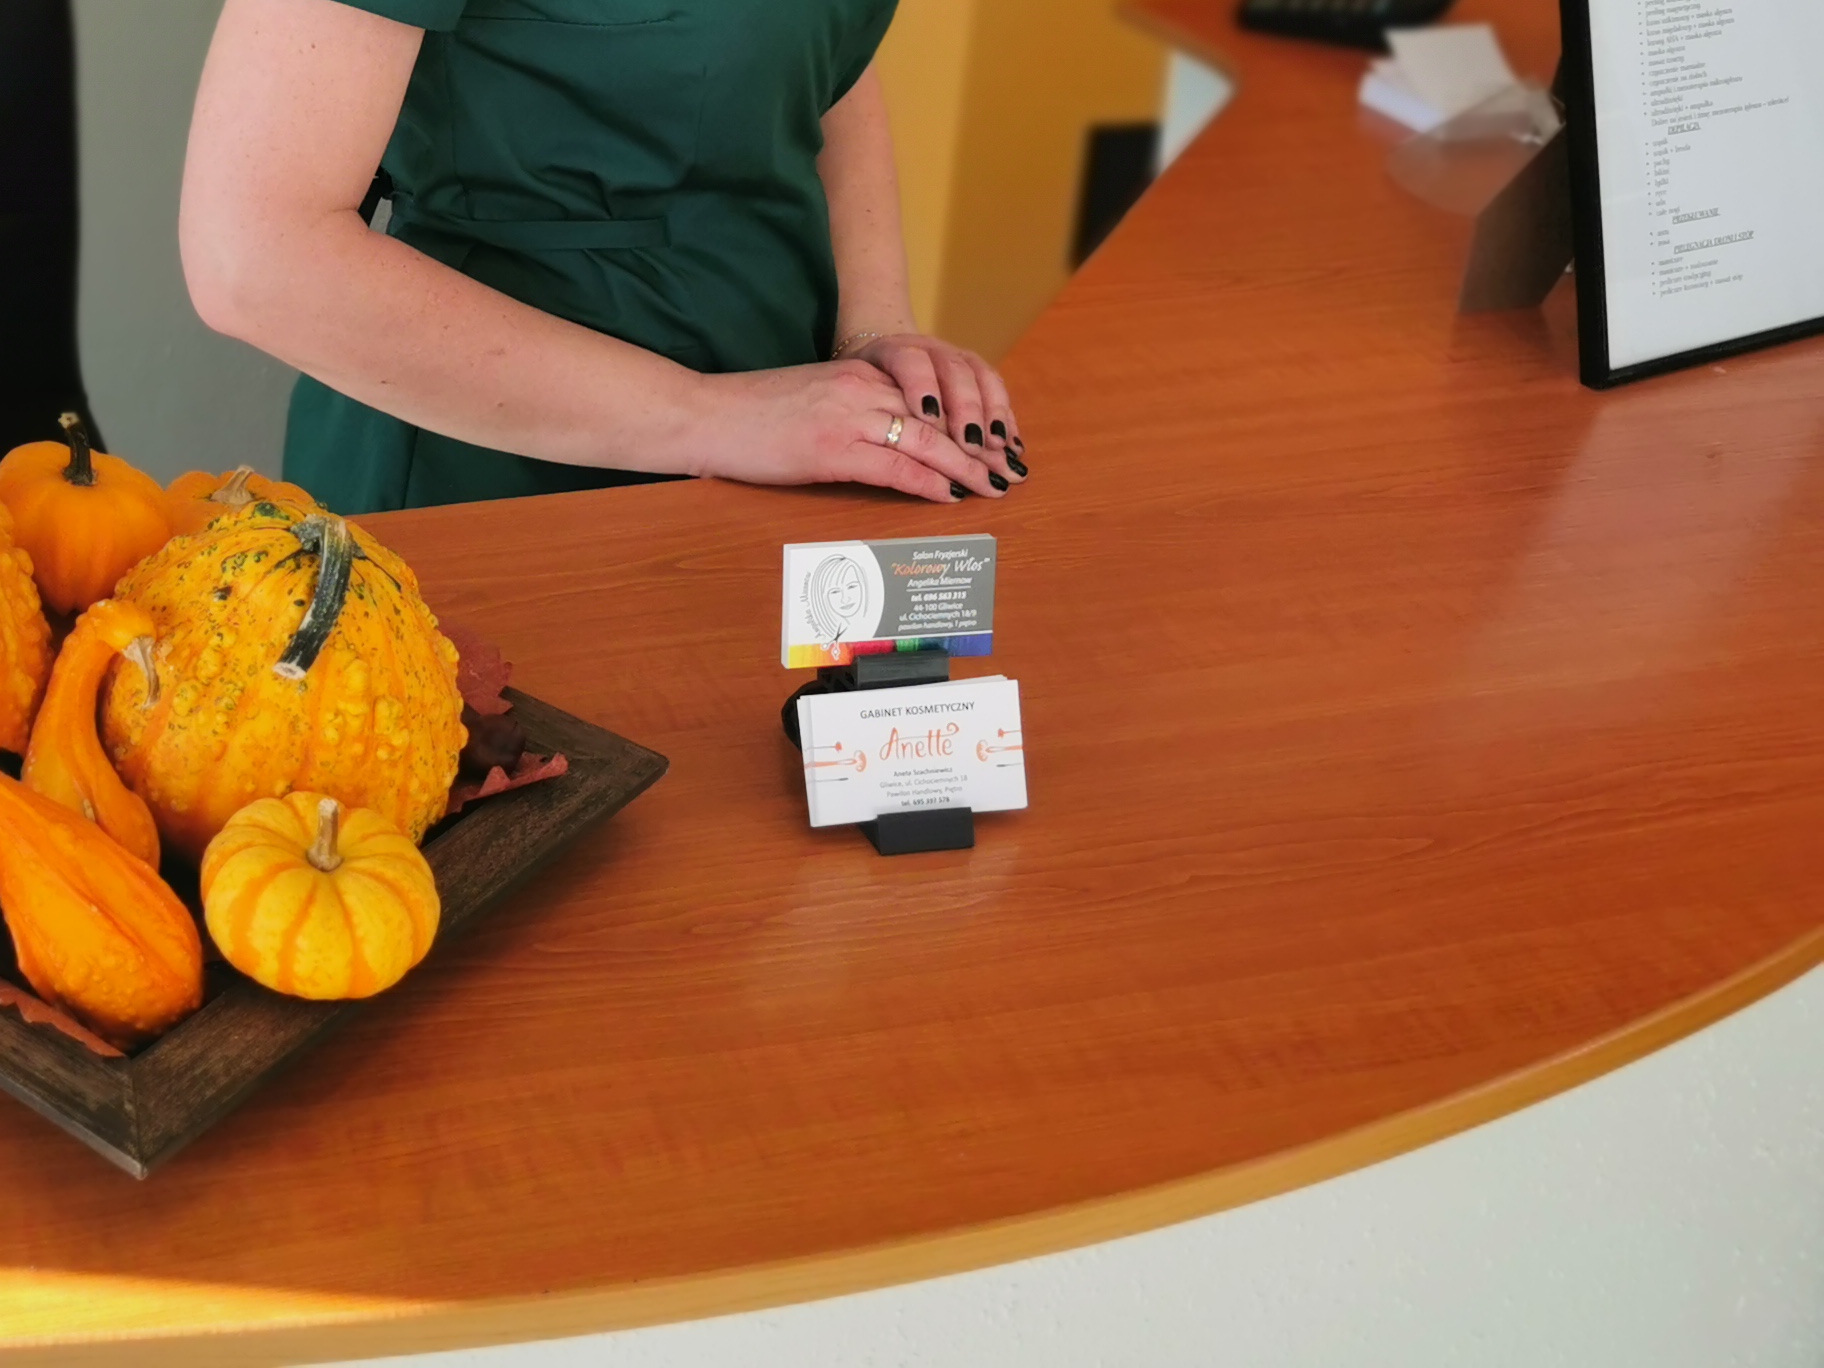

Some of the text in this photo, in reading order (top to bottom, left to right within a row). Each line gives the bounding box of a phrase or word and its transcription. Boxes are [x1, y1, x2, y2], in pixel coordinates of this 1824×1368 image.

[860, 701, 975, 719] GABINET KOSMETYCZNY
[879, 722, 960, 760] Anette
